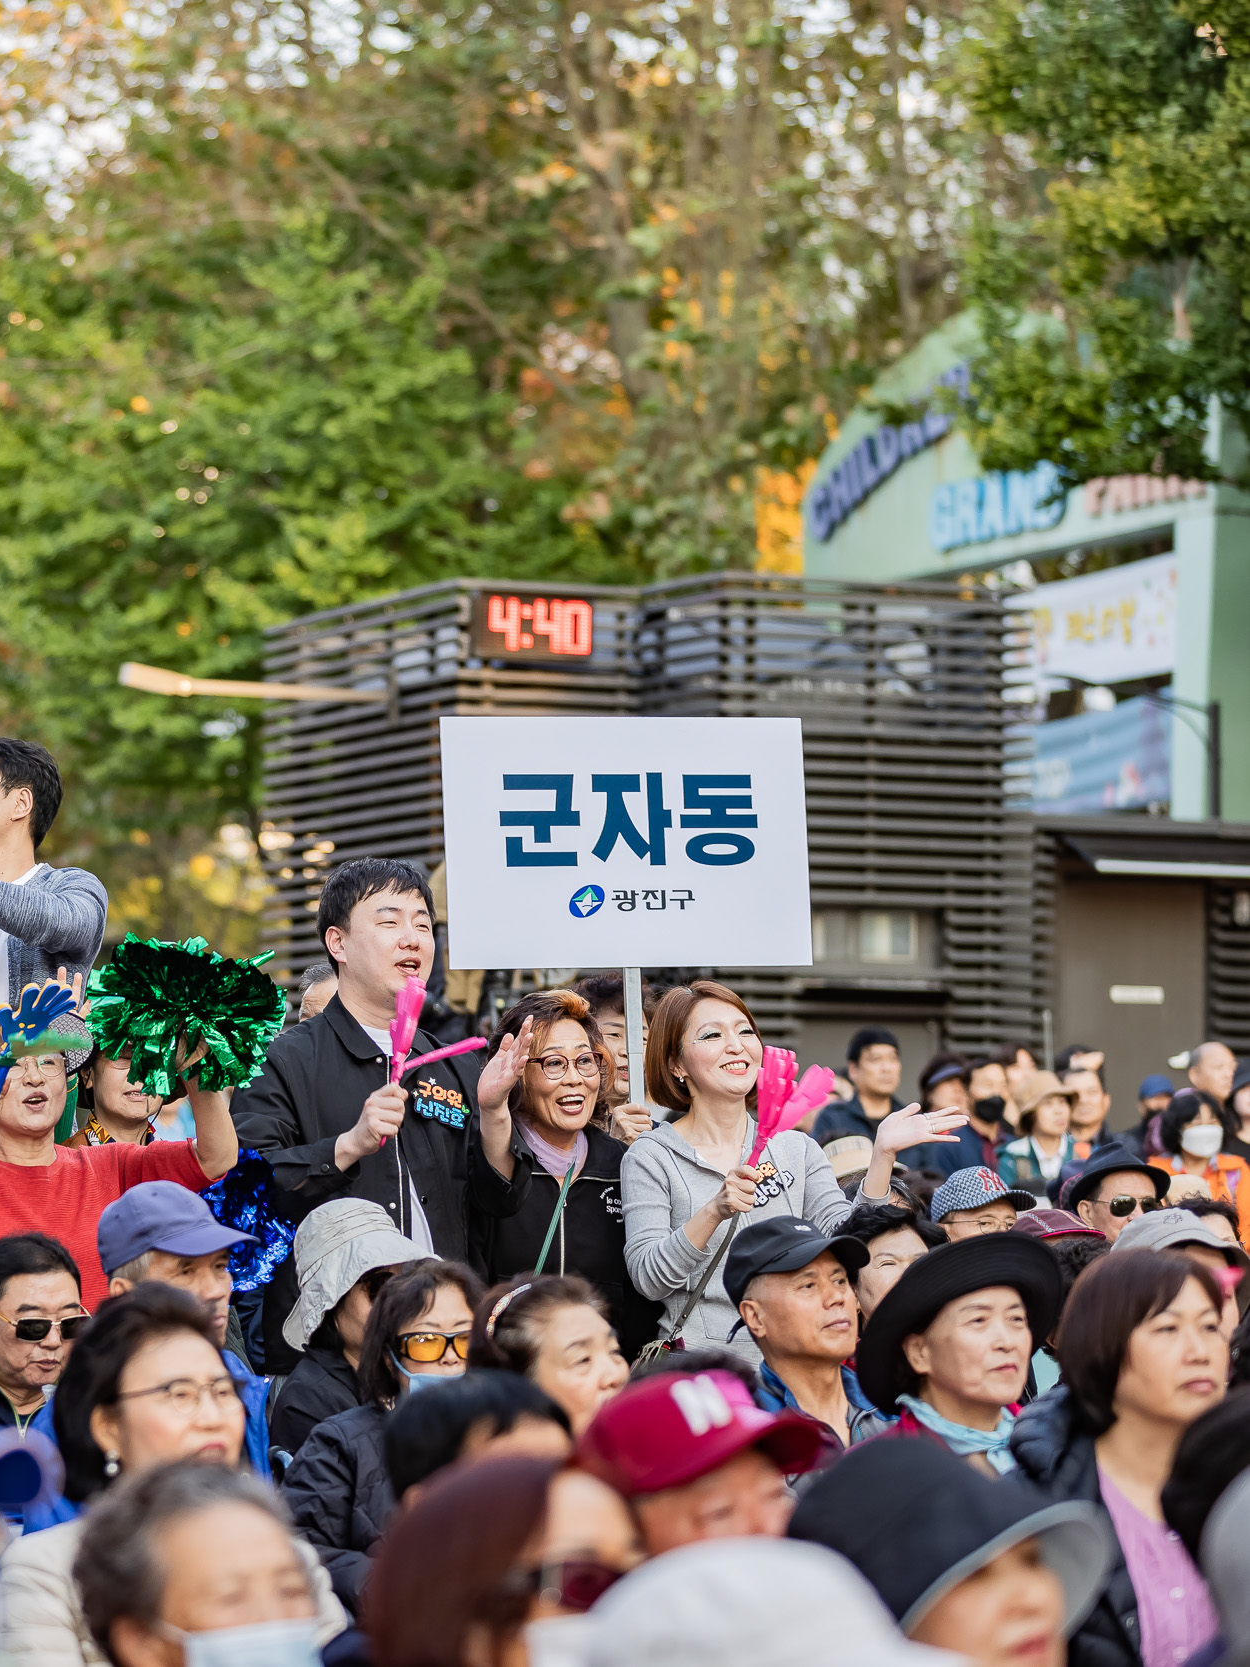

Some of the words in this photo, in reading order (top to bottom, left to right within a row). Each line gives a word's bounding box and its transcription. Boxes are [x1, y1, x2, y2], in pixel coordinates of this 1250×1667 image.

[488, 595, 593, 656] 4:40
[498, 771, 759, 868] 군자동
[610, 888, 696, 912] 광진구
[417, 1080, 463, 1109] 구의원
[977, 1167, 1007, 1192] NY
